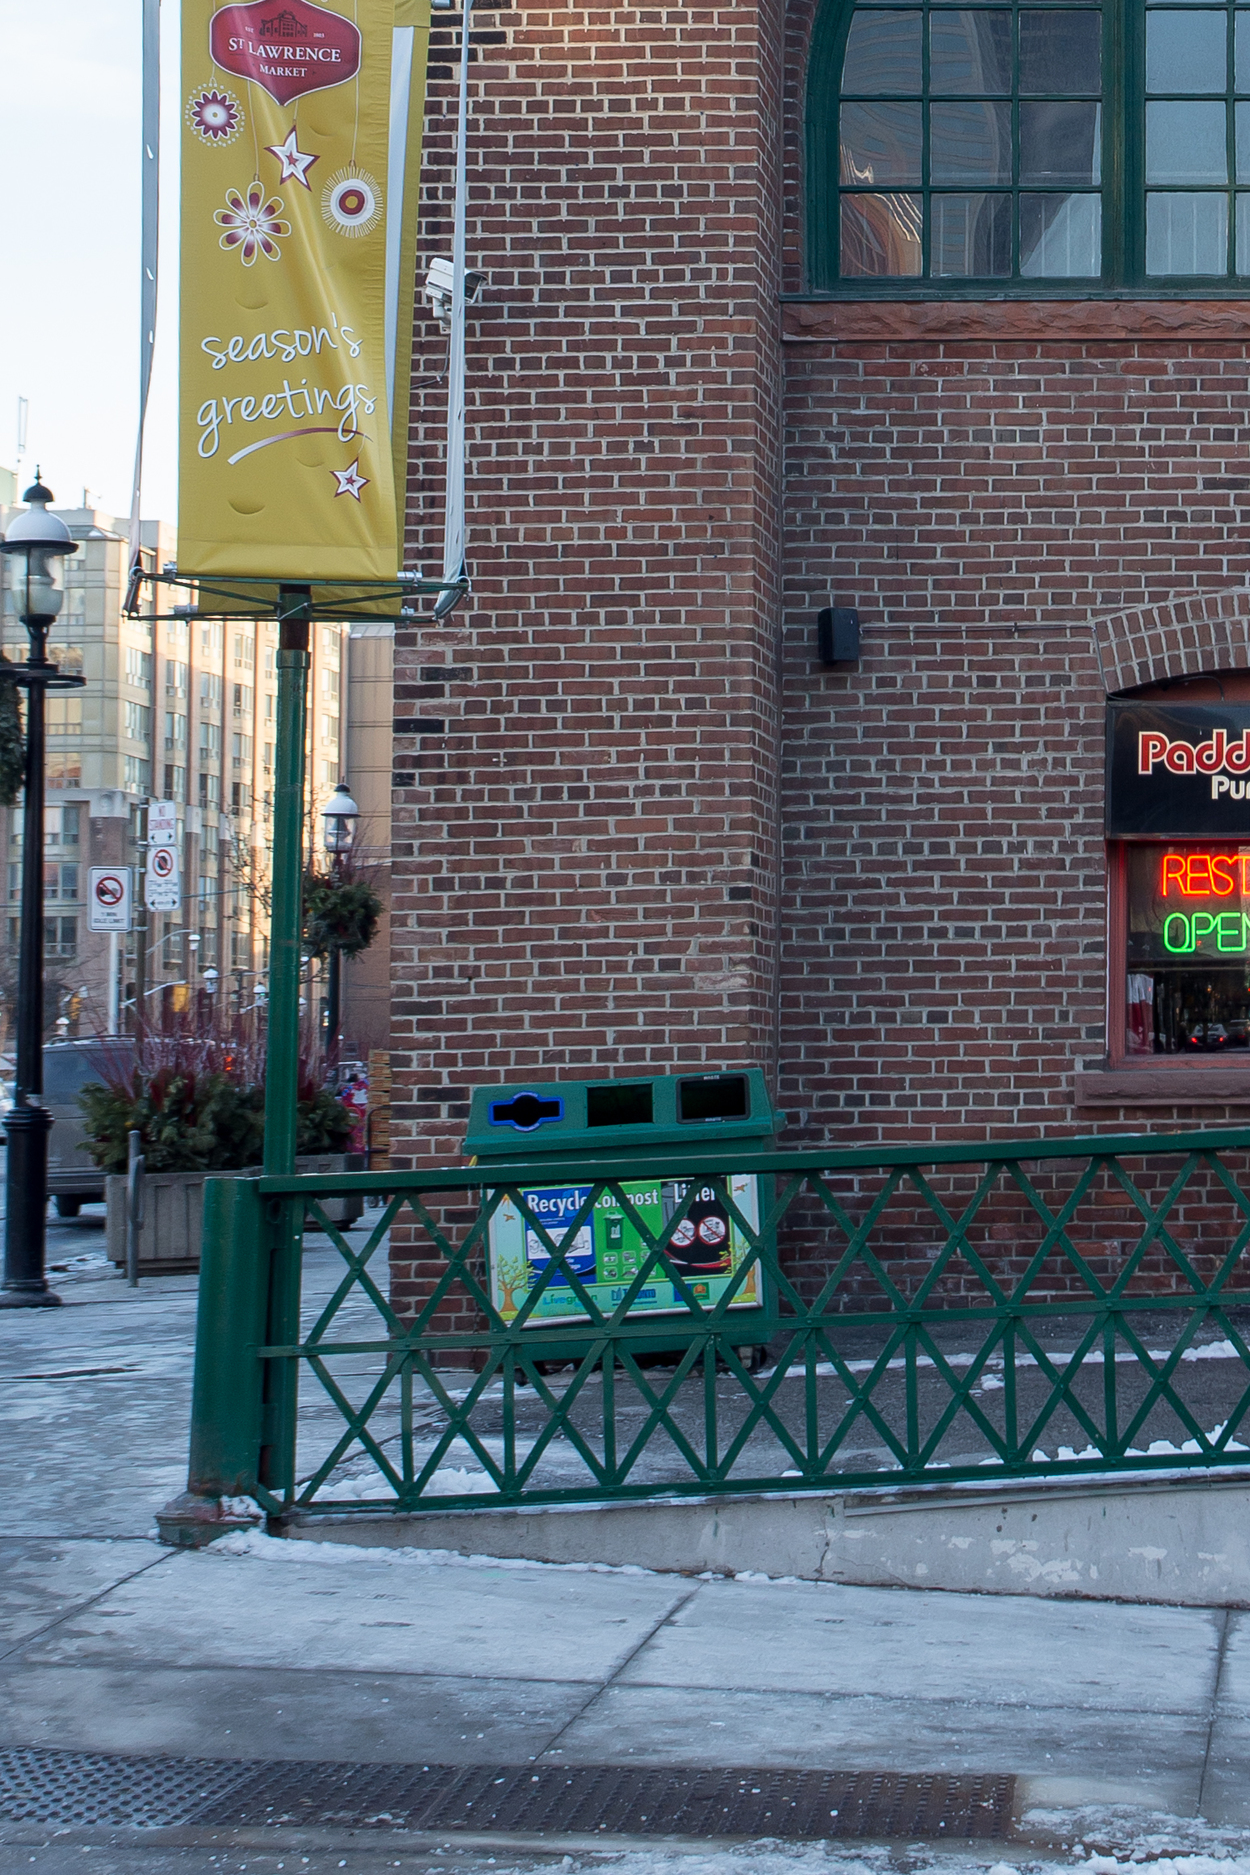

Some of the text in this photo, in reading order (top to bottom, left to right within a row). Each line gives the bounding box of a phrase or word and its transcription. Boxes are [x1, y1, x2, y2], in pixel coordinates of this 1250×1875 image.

[248, 41, 341, 63] LAWRENCE
[259, 63, 307, 78] MARKET
[200, 312, 364, 370] season's
[196, 378, 377, 458] greetings
[673, 1183, 716, 1203] Lier
[542, 1294, 598, 1305] Livegrn
